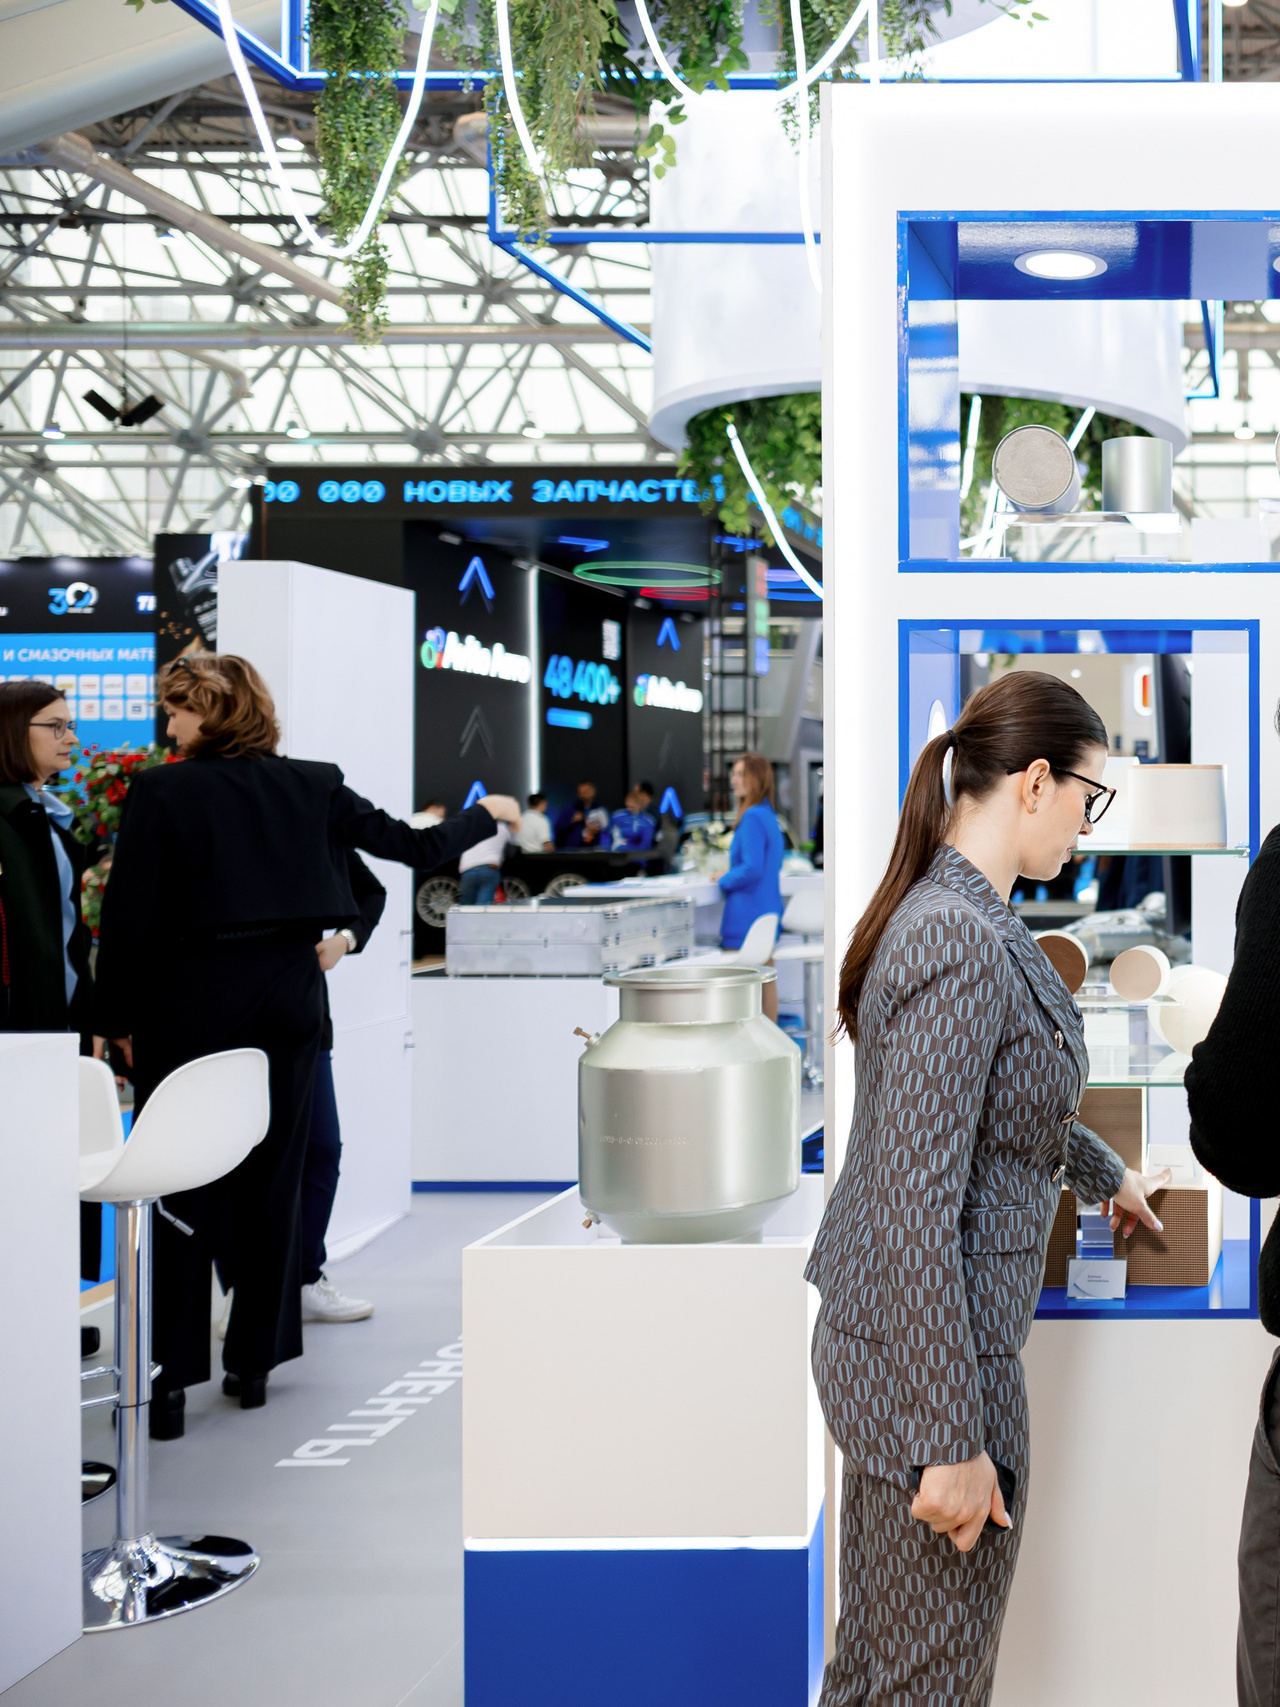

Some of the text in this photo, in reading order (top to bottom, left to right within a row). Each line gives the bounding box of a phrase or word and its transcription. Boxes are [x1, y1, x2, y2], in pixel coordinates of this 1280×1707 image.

[317, 480, 386, 503] 000
[403, 480, 514, 503] НОВЫХ
[3, 649, 15, 662] И
[17, 648, 114, 663] СМАЗОЧНЫХ
[274, 1334, 463, 1467] НЕНТЫ
